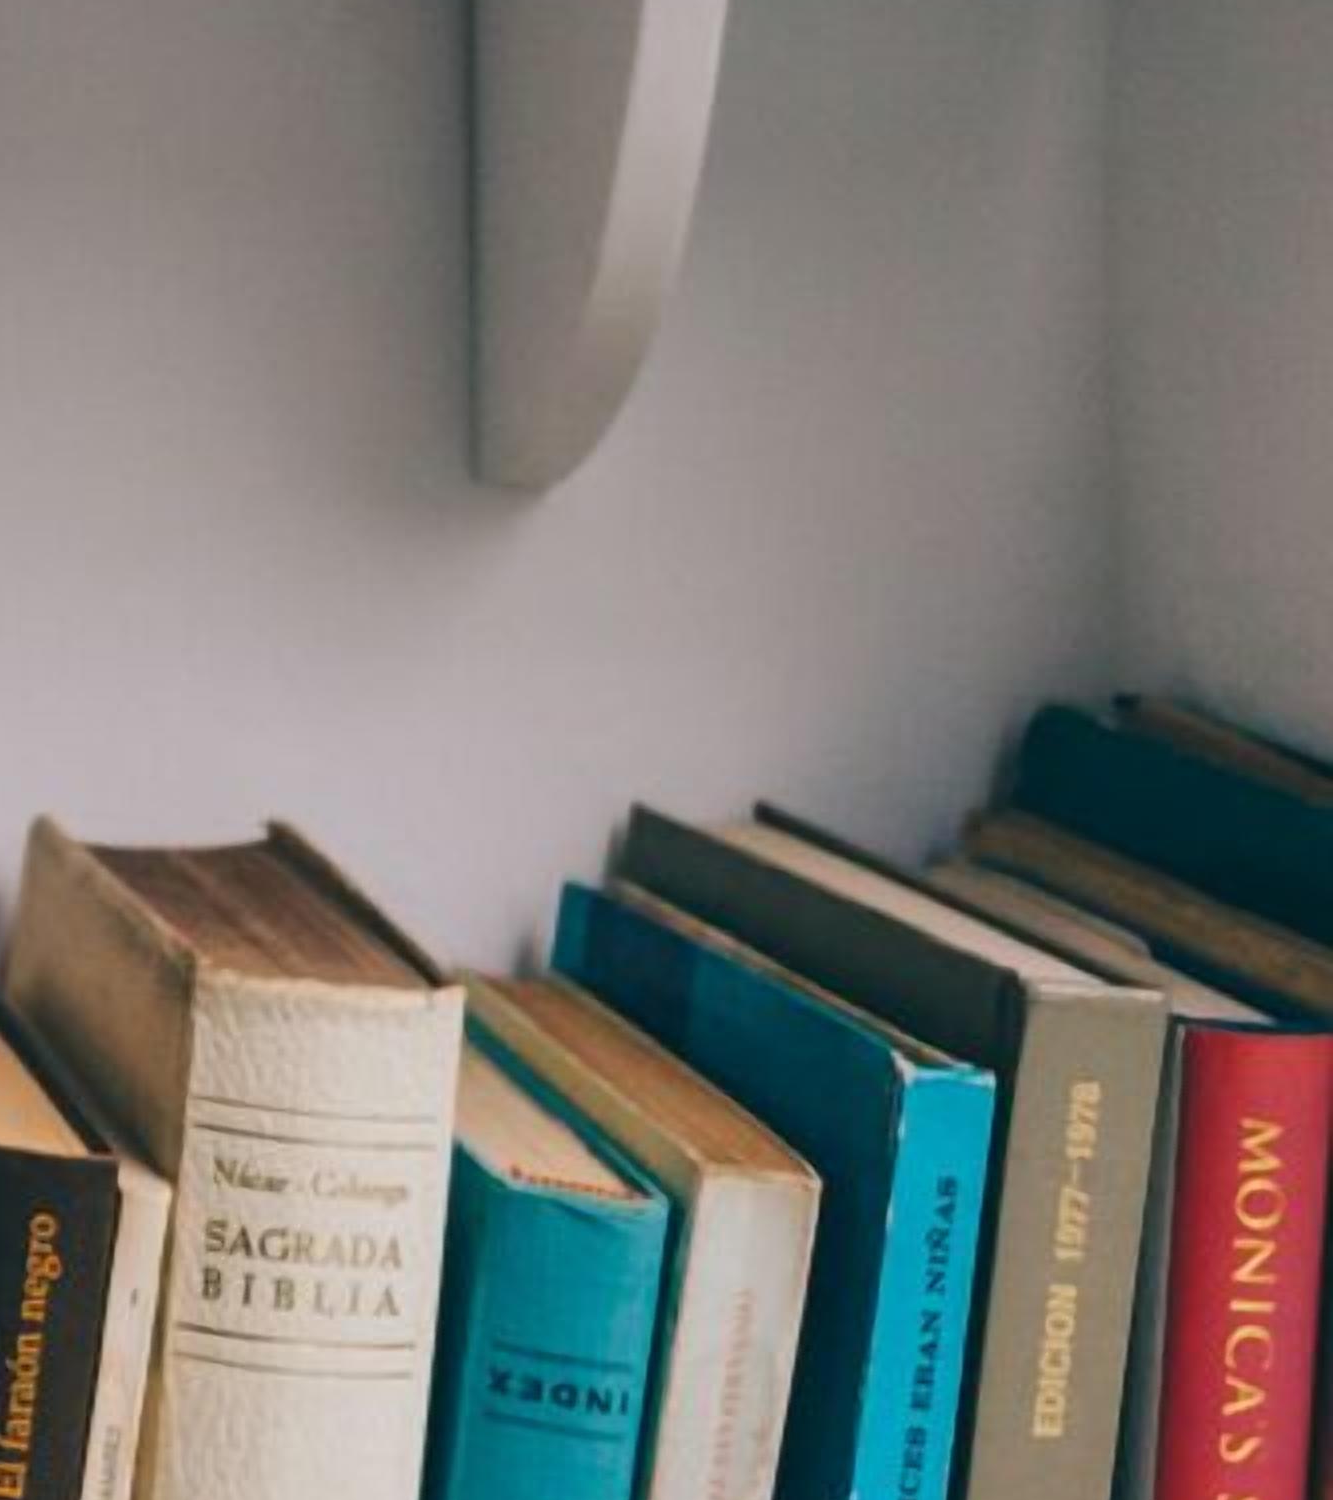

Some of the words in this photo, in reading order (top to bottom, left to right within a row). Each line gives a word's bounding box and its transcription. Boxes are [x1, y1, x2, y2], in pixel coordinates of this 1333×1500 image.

[21, 1213, 62, 1322] negro
[203, 1216, 397, 1265] SAGRADA
[925, 1176, 958, 1295] NIÑAS
[200, 1262, 396, 1314] BIBLIA
[487, 1365, 634, 1423] INDEX
[910, 1311, 941, 1411] ERAN
[1032, 1284, 1077, 1437] EDICION
